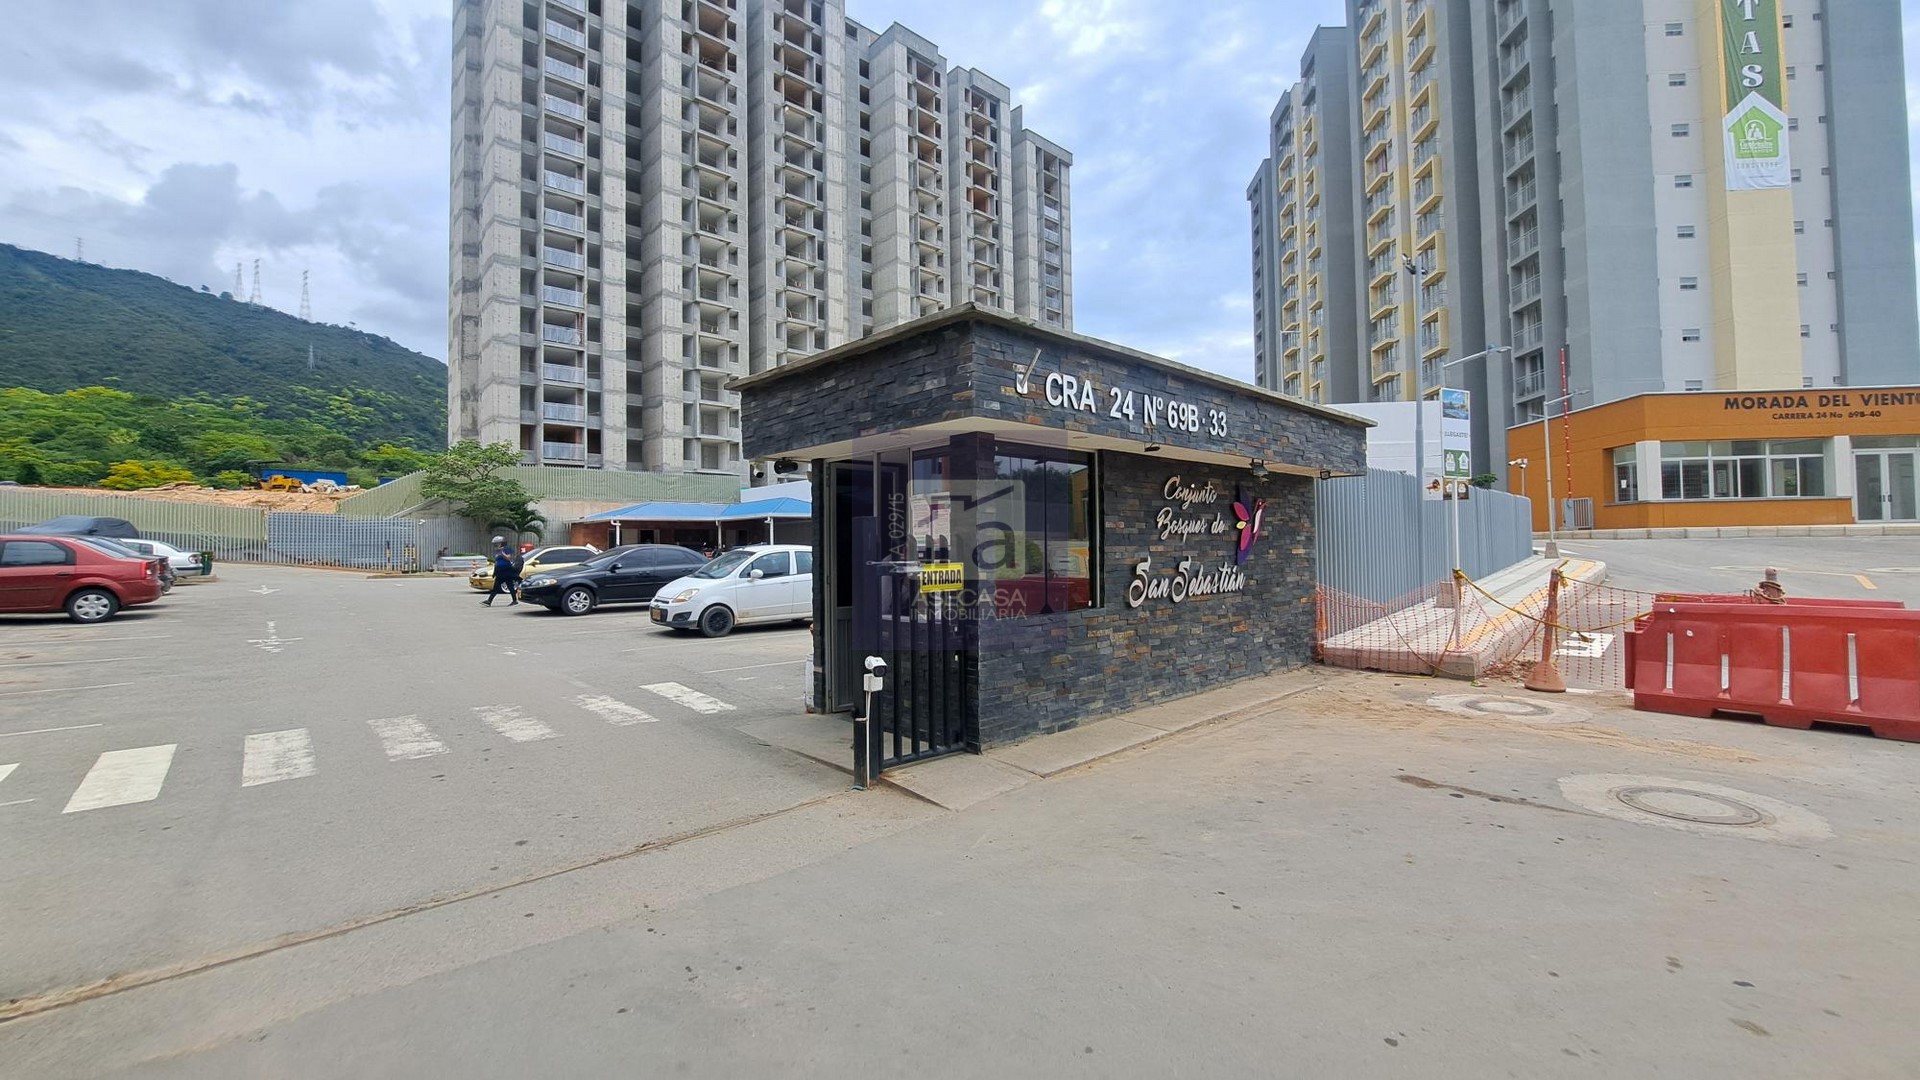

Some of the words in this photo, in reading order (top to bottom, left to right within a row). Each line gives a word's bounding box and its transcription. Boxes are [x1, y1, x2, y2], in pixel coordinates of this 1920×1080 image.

[1045, 372, 1097, 414] CRA
[1110, 387, 1135, 421] 24
[1724, 395, 1809, 410] MORADA
[1819, 393, 1850, 408] DEL
[1772, 411, 1814, 420] CARRERA
[1816, 411, 1828, 419] 24
[1164, 475, 1218, 510] Conjunto
[1156, 506, 1208, 543] Bosques
[1211, 512, 1226, 535] de
[922, 569, 963, 586] ENTRADA
[1129, 554, 1170, 608] San
[1171, 555, 1246, 603] Sebastián
